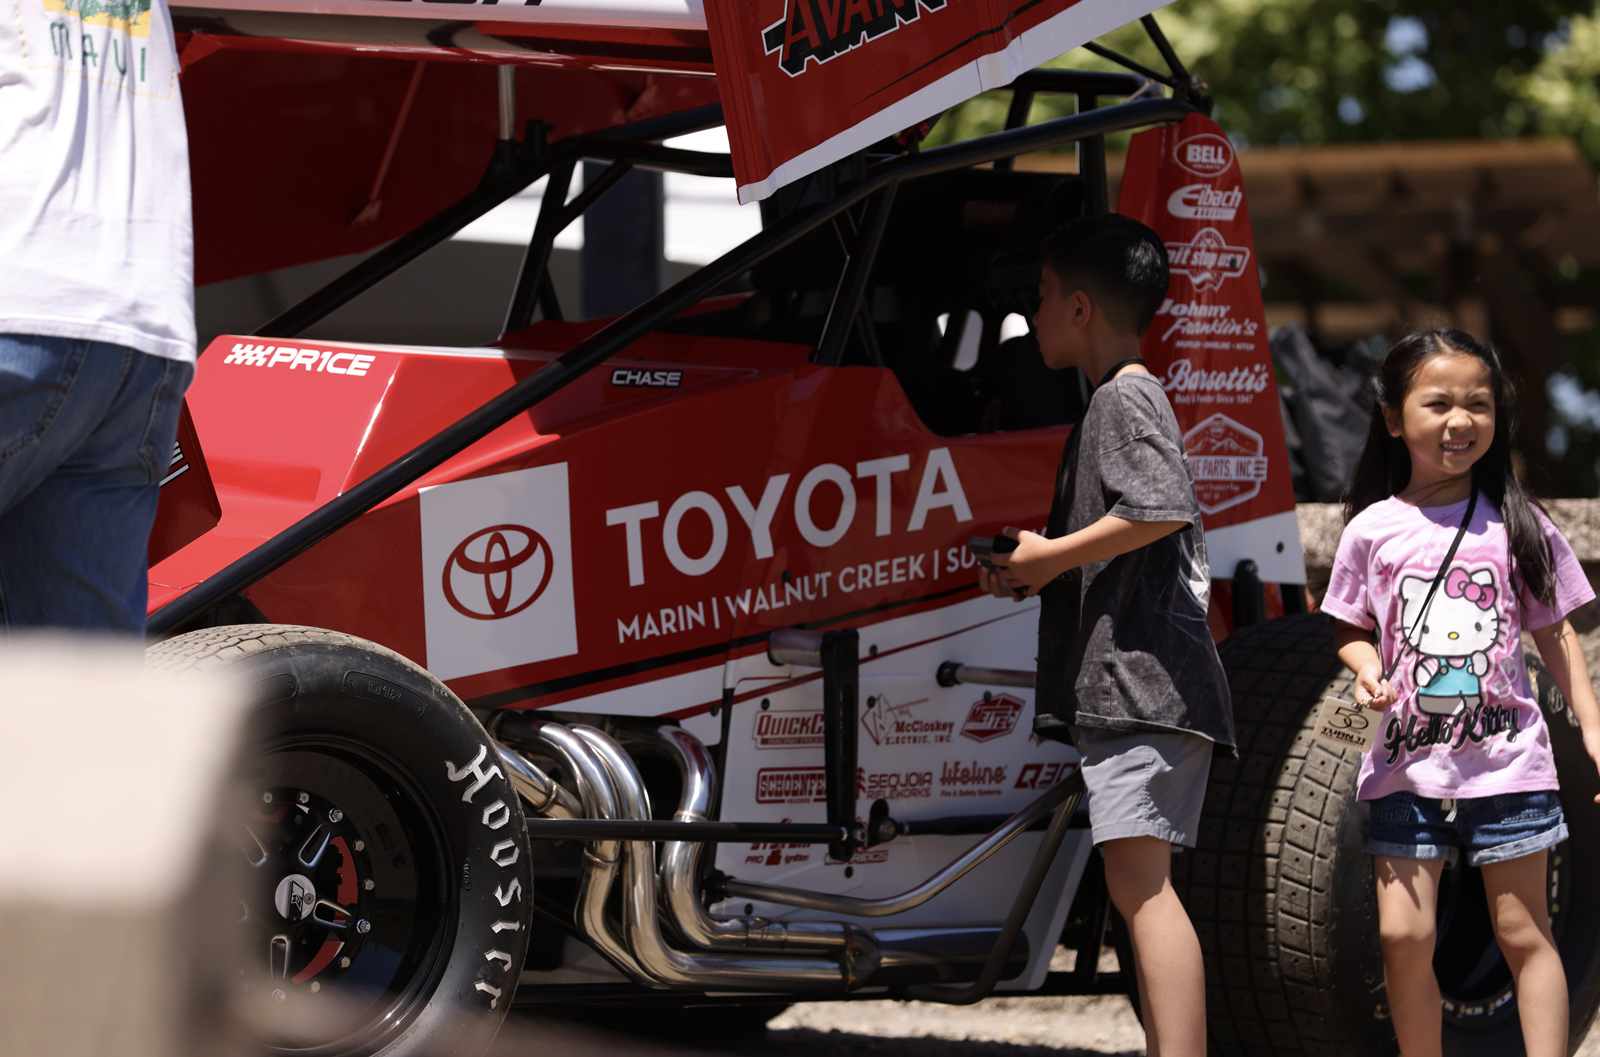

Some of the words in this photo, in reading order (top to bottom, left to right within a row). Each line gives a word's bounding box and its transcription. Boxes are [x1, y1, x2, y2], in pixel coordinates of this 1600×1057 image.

[50, 22, 146, 82] MAUI
[1187, 144, 1225, 164] BELL
[1167, 183, 1243, 220] Eibach
[1191, 247, 1218, 270] stop
[1156, 299, 1231, 318] Johnny
[1161, 317, 1258, 342] Franklin's
[611, 370, 682, 386] CHASE
[1159, 358, 1269, 393] Barsotti's
[605, 447, 974, 587] TOYOTA
[617, 600, 704, 644] MARIN
[724, 570, 831, 620] WALNUT
[838, 553, 926, 593] CREEK
[757, 714, 825, 736] QUICKC
[895, 719, 955, 734] McCloskey
[1384, 713, 1453, 765] Hello
[1452, 704, 1520, 749] Kitty
[760, 773, 826, 797] SCHOENFE
[868, 771, 933, 790] SEQUOIA
[745, 855, 764, 865] PRO
